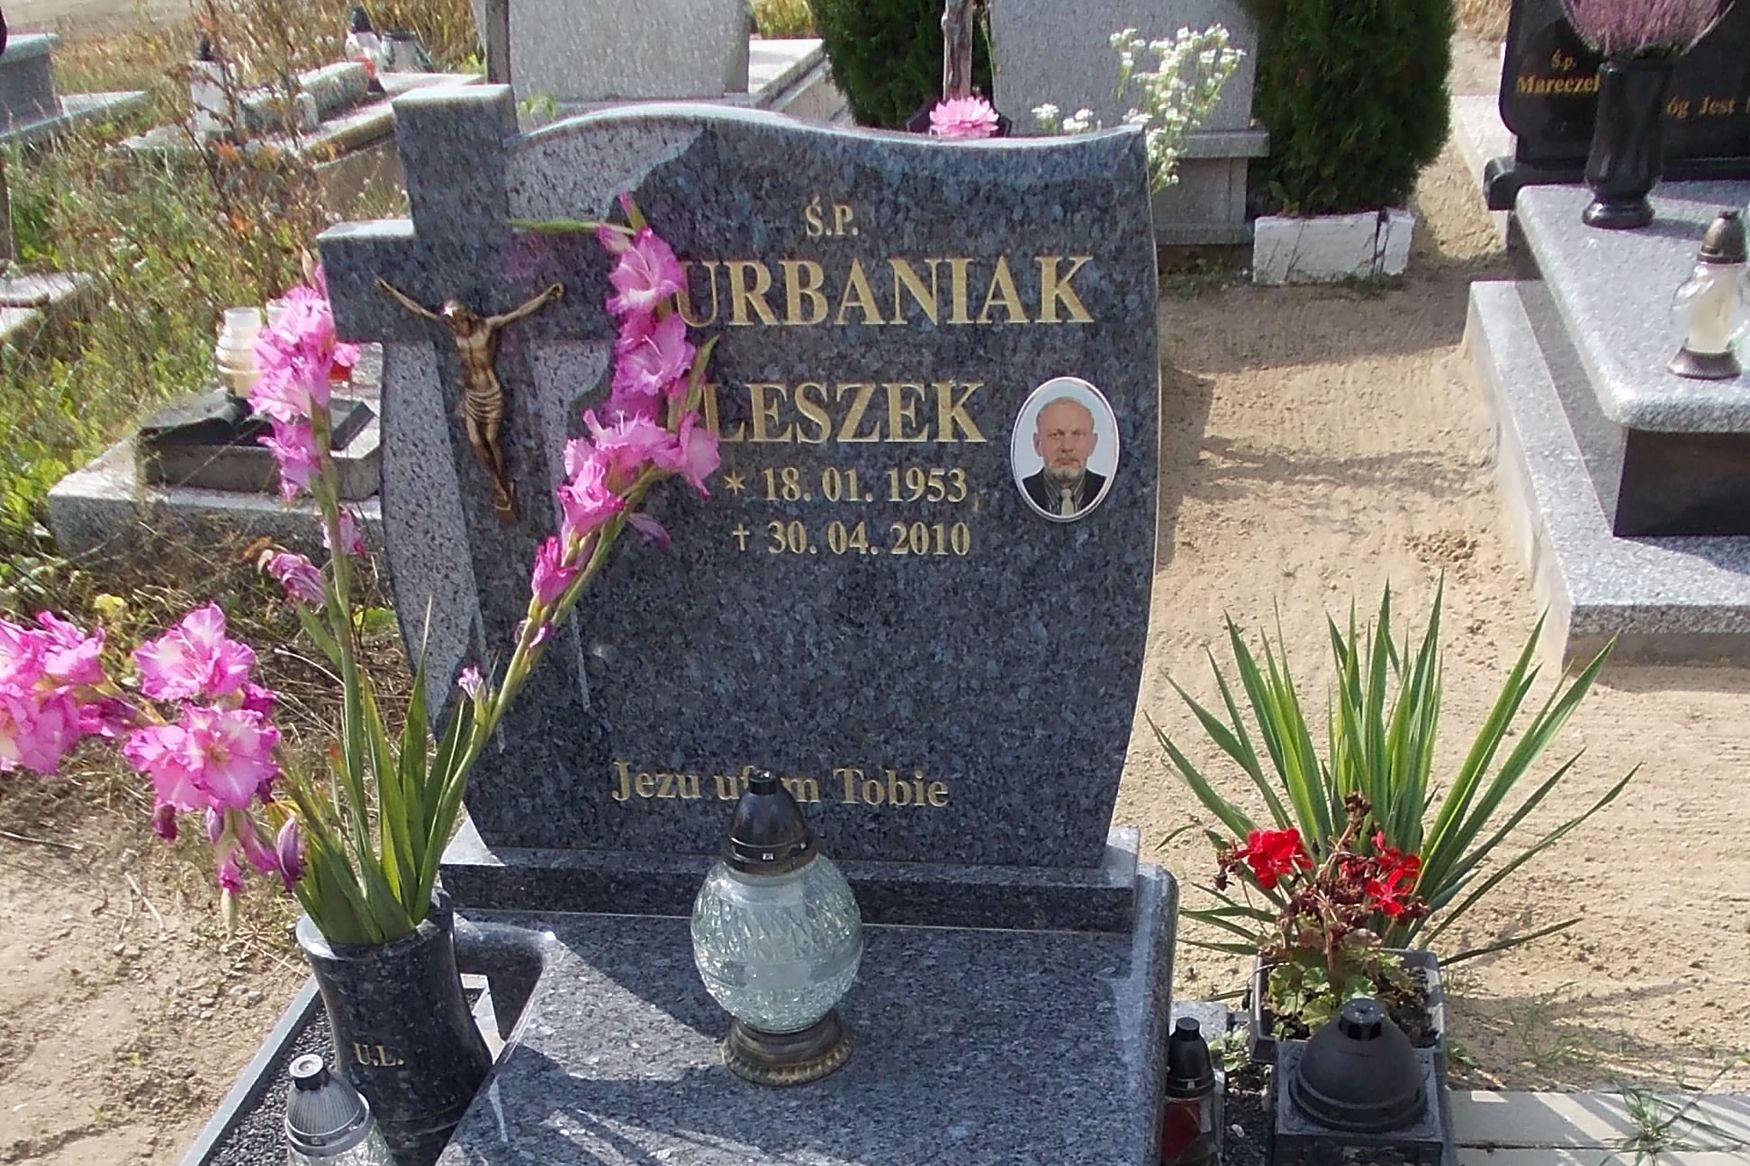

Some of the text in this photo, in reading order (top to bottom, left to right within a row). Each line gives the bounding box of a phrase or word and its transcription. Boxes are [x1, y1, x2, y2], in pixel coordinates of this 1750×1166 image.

[1666, 96, 1690, 119] óg
[805, 196, 860, 237] Ś.P.
[676, 255, 1095, 327] URBANIAK
[703, 381, 987, 444] LESZEK
[612, 761, 950, 807] Jezu ufm Tobie
